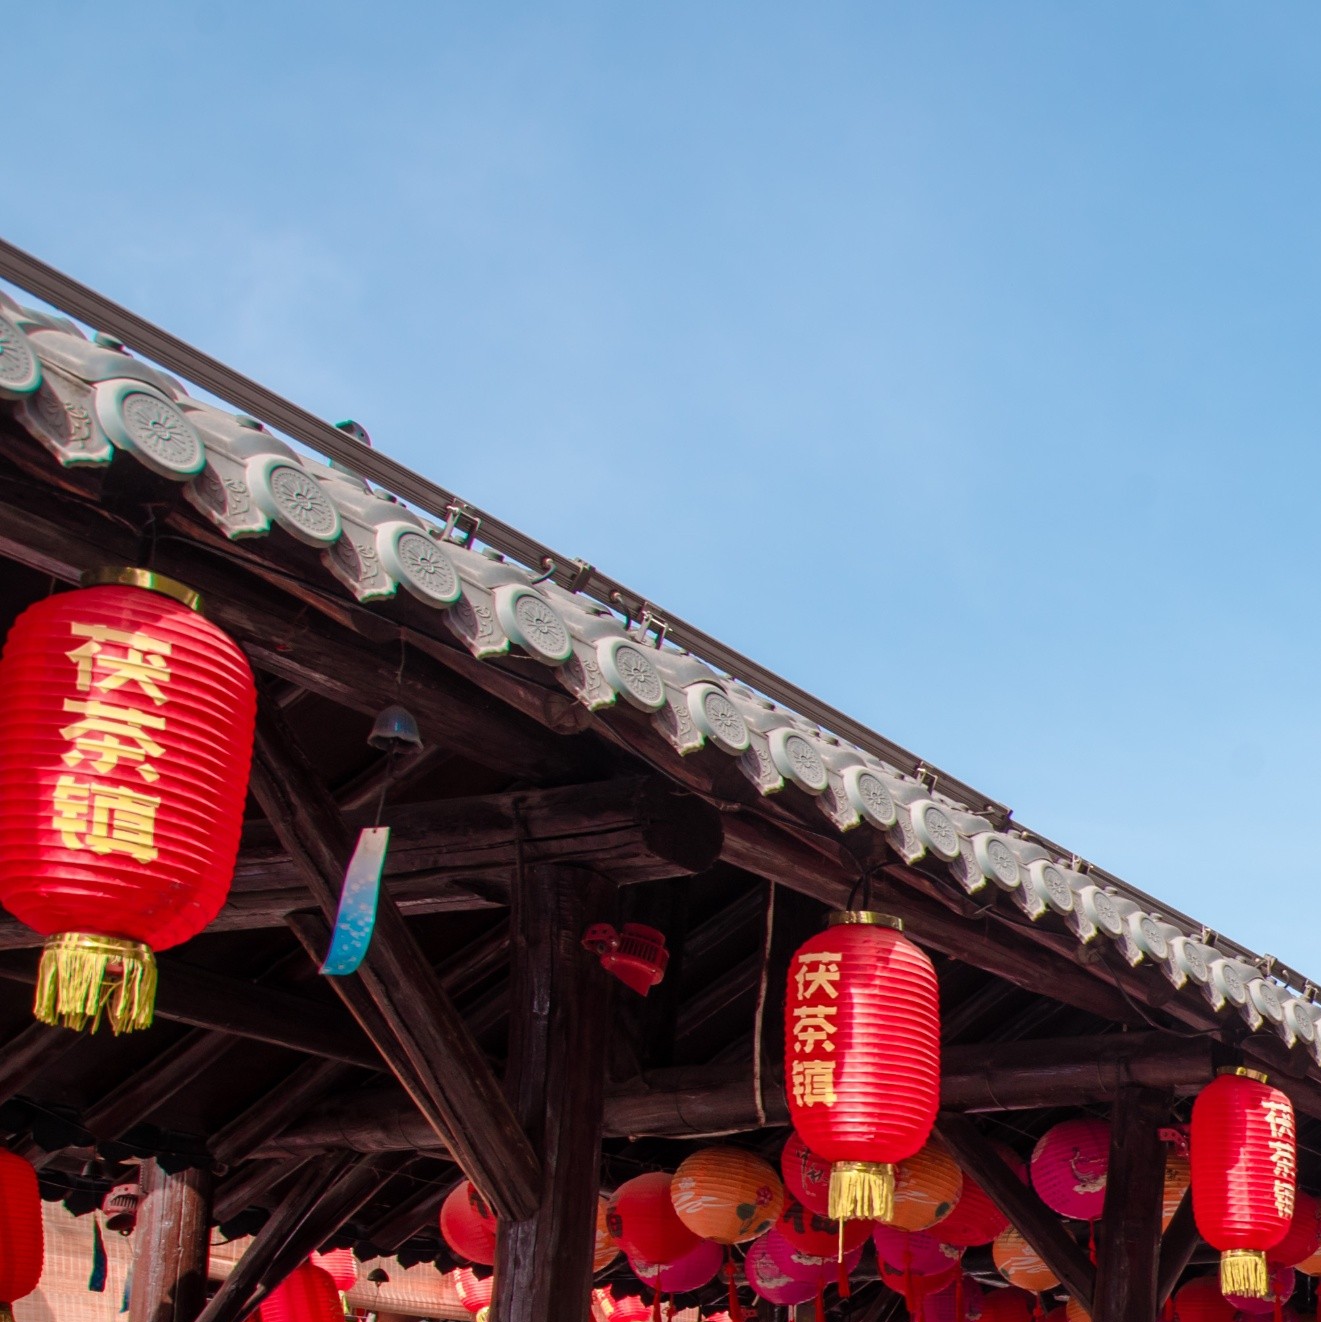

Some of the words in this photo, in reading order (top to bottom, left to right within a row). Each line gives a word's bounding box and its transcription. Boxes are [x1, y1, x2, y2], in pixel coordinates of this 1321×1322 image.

[53, 621, 173, 865] 茯茶镇
[791, 951, 842, 1108] 茯茶镇
[1261, 1098, 1296, 1219] 茯茶镇
